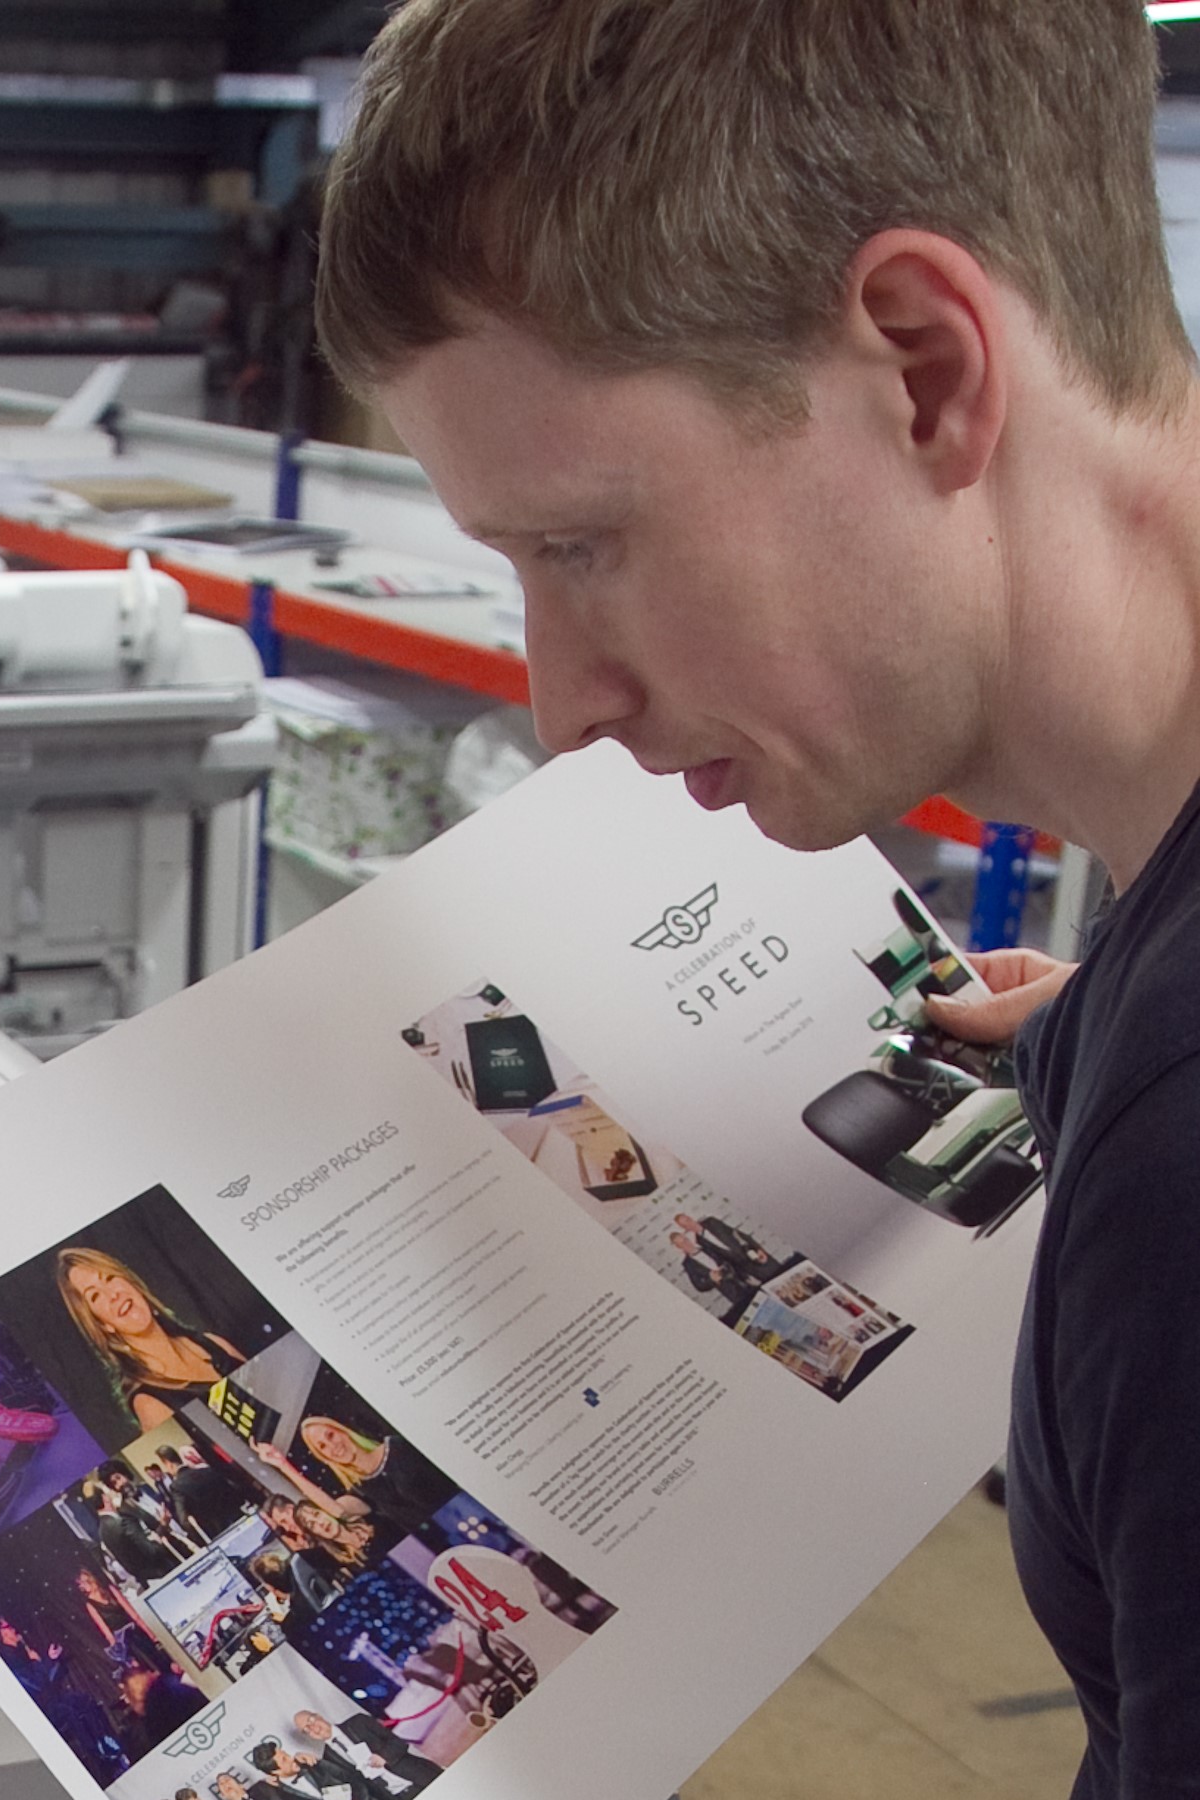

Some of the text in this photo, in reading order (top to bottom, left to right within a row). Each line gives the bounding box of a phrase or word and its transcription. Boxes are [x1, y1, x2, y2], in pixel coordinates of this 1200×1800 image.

[674, 931, 742, 984] CELEBRATION
[740, 917, 756, 934] OF
[677, 935, 789, 1025] SPEED
[237, 1163, 336, 1231] SPONSORSHIP
[326, 1119, 401, 1172] PACKAGES
[651, 1457, 694, 1496] BURRELLS
[434, 1557, 529, 1631] 24
[190, 1736, 244, 1785] CELEBRATION
